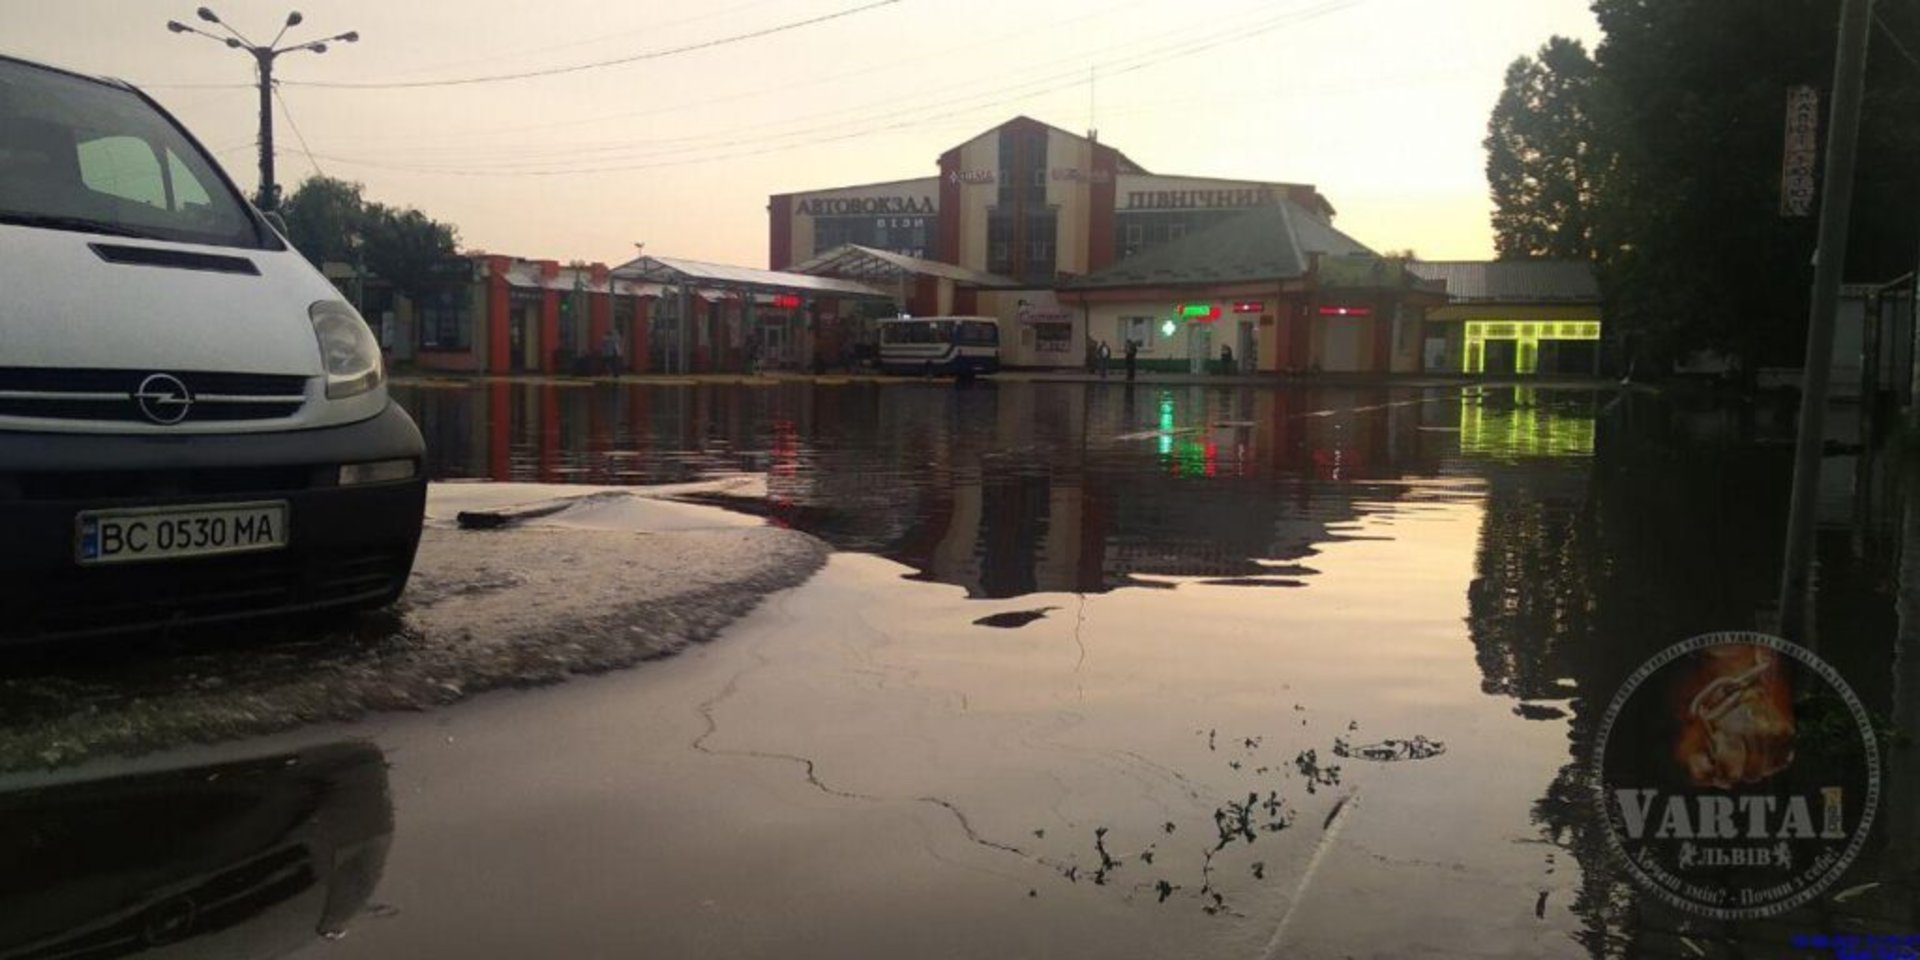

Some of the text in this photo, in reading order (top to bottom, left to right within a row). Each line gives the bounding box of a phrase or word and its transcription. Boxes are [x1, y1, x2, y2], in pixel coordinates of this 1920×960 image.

[796, 195, 935, 215] АВТОВОКЗАЛ
[877, 217, 924, 228] ВІЗИ
[157, 518, 226, 550] 0530
